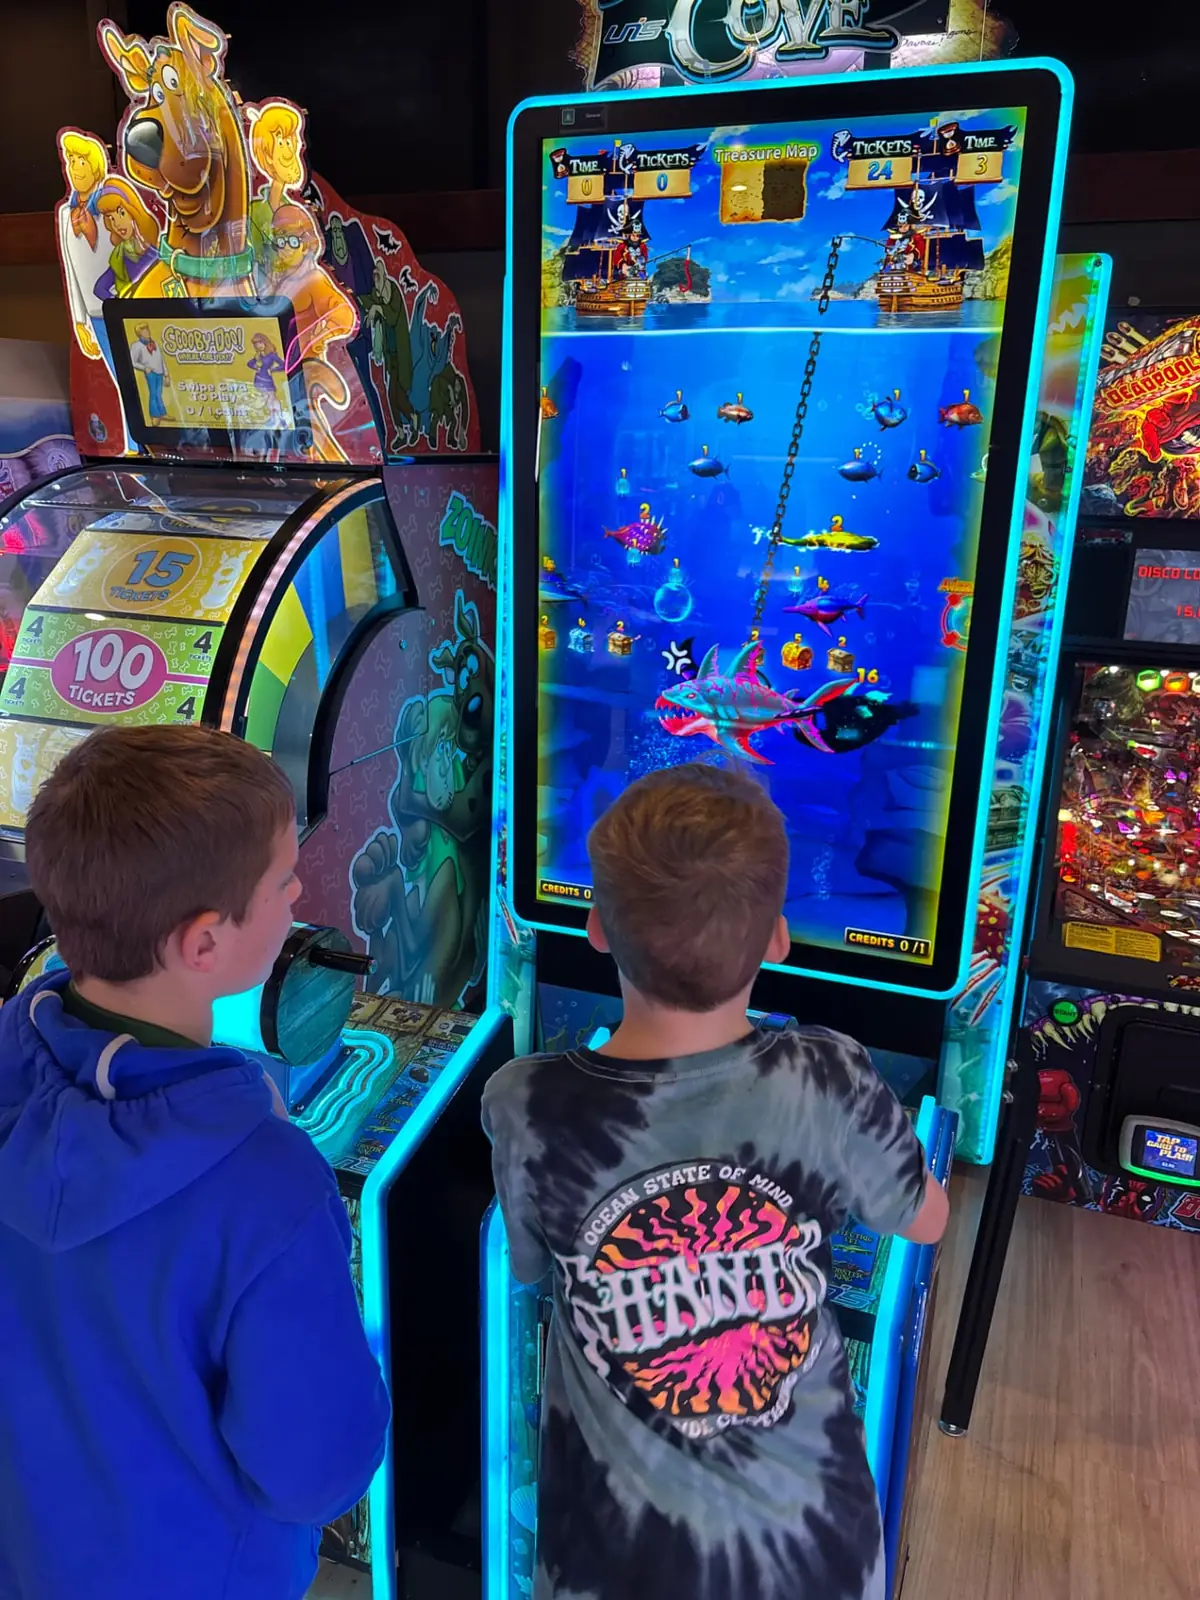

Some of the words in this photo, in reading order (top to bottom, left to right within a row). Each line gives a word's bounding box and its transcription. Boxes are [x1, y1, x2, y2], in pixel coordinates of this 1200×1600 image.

[715, 146, 784, 163] Treasure
[785, 143, 818, 161] Map
[853, 139, 913, 156] TICKETS
[637, 152, 690, 169] TICKETS
[974, 155, 988, 175] 3
[867, 161, 893, 180] 24
[581, 179, 592, 196] 0
[656, 173, 668, 191] 0
[178, 383, 215, 393] Swipe
[218, 383, 248, 392] Card
[1106, 355, 1200, 405] DEADPOOL
[192, 393, 209, 401] To
[212, 393, 237, 403] Play
[639, 503, 651, 519] 2
[831, 515, 843, 532] 2
[127, 551, 195, 588] 15
[1138, 566, 1181, 580] DISCO
[818, 576, 829, 592] 4
[110, 586, 170, 602] TICKETS
[26, 615, 45, 637] 4
[193, 631, 213, 653] 4
[74, 633, 154, 690] 100
[857, 667, 878, 683] 16
[8, 677, 26, 699] 4
[69, 685, 136, 707] TICKETS
[177, 696, 196, 720] 4
[542, 883, 580, 897] CREDITS
[584, 889, 591, 899] 0
[849, 932, 895, 948] CREDITS
[1147, 1141, 1172, 1150] CARD
[1174, 1145, 1188, 1153] TO
[1157, 1135, 1181, 1145] TAP
[584, 1188, 640, 1246] OCEAN
[643, 1164, 711, 1195] STATE
[719, 1165, 747, 1181] OF
[749, 1174, 794, 1208] MIND
